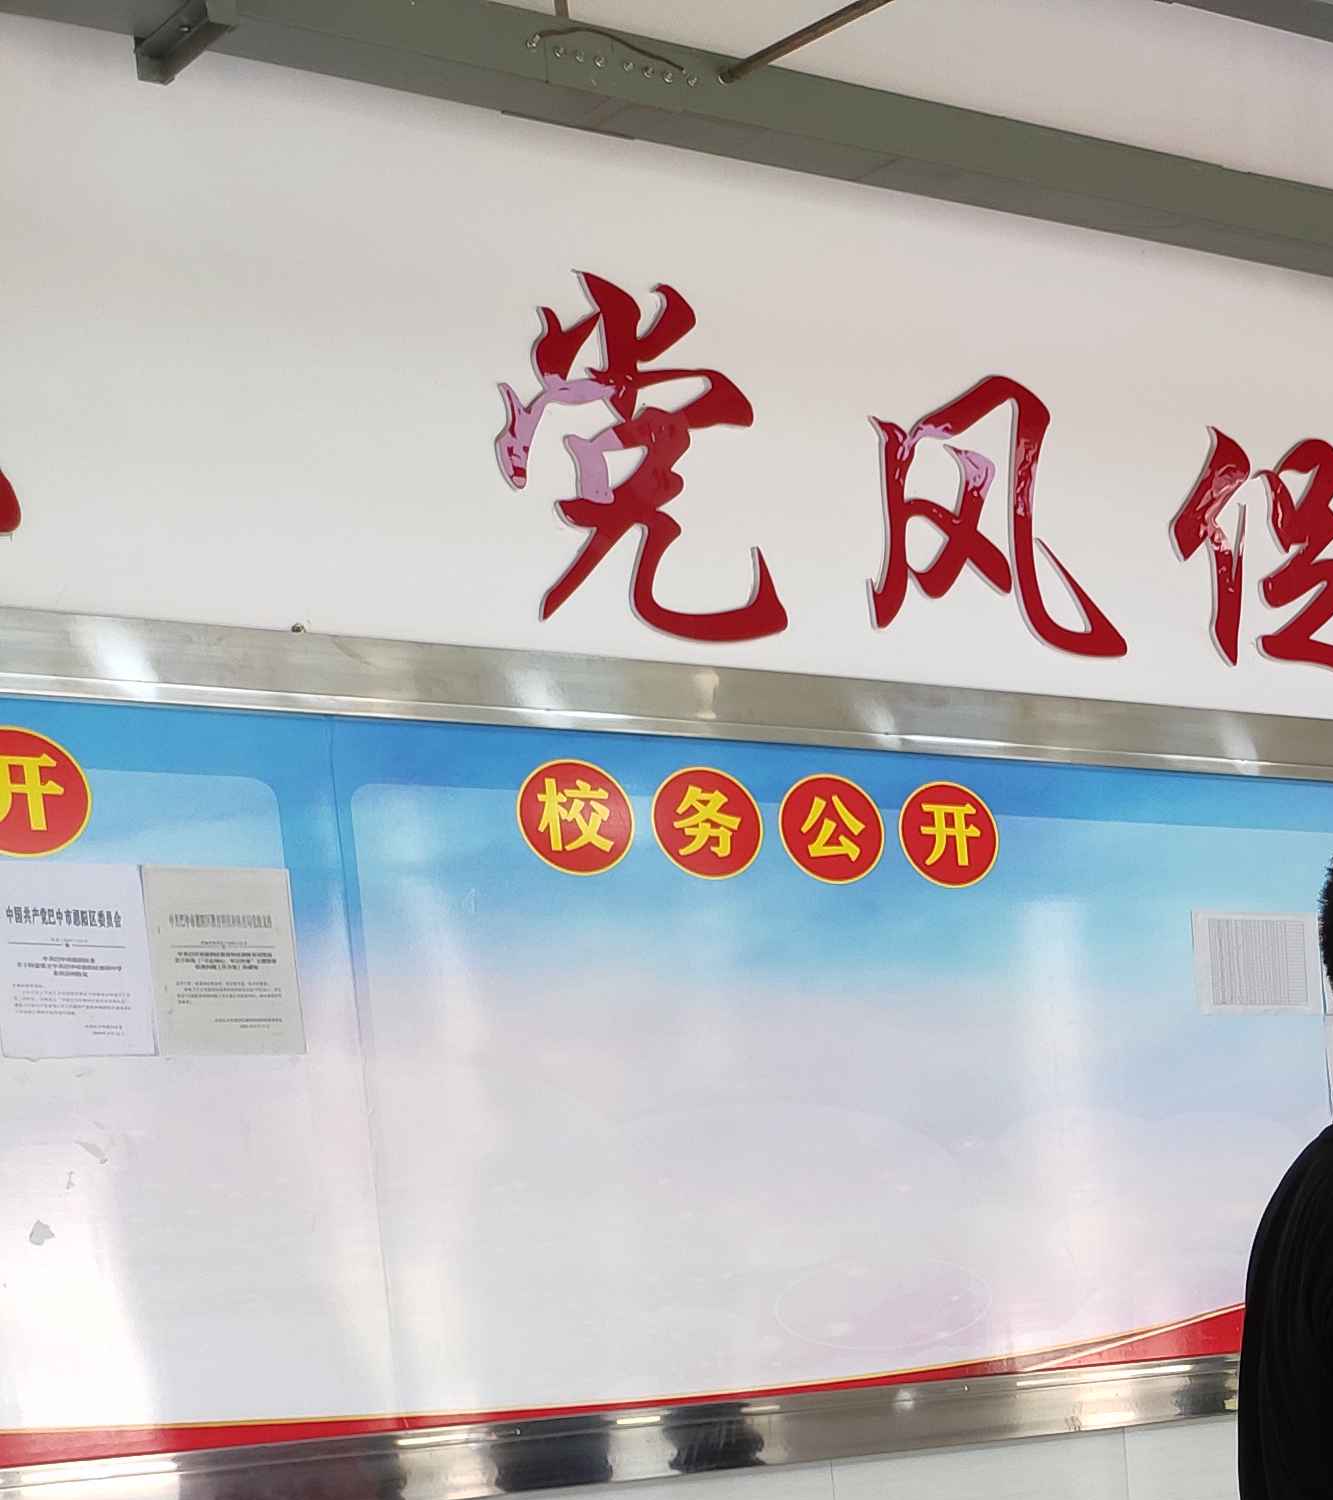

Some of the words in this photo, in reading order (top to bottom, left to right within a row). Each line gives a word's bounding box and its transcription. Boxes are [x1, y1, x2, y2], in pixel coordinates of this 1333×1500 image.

[0, 753, 64, 831] 开
[536, 777, 982, 866] 校务公开
